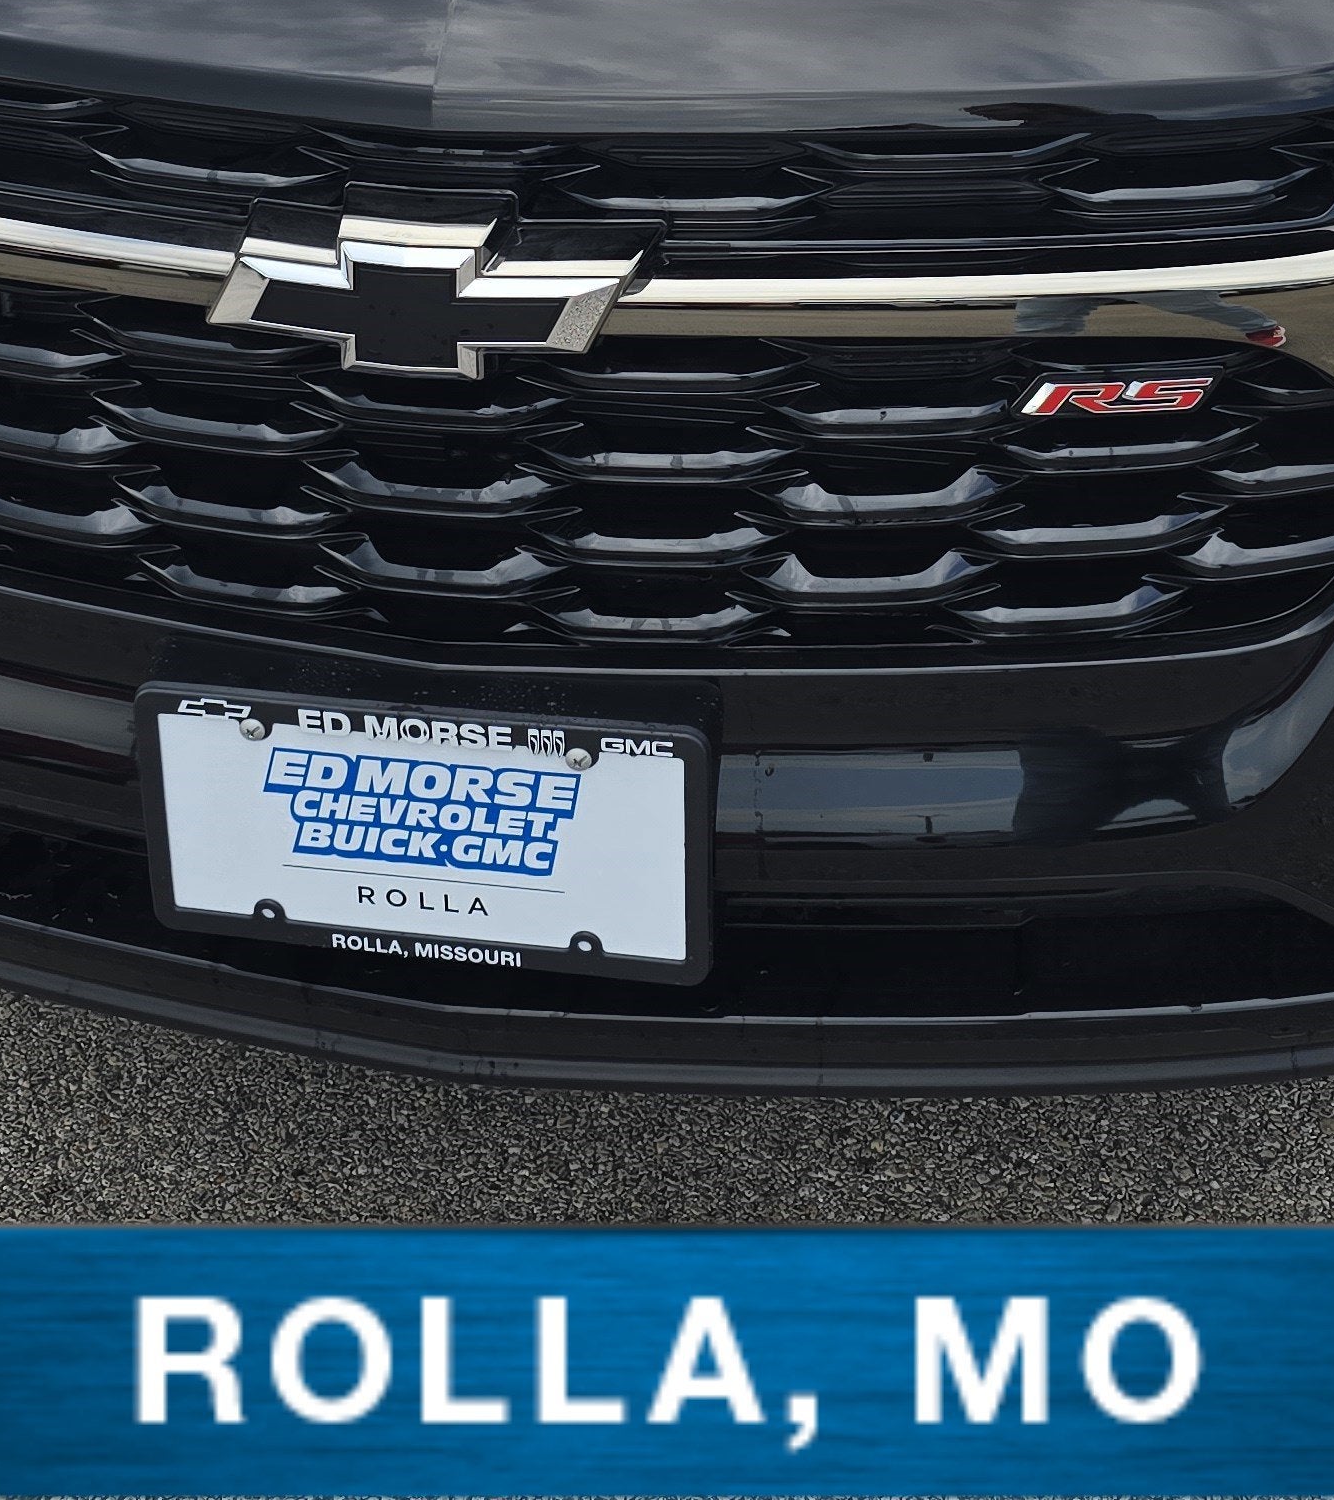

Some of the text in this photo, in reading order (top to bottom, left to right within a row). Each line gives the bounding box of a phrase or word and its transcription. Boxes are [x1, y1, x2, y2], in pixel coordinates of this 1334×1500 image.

[1020, 377, 1214, 416] RS
[297, 708, 514, 751] ED MORSE
[599, 737, 675, 758] GMC
[267, 750, 578, 811] ED MORSE
[292, 790, 555, 840] CHEVROLET
[357, 885, 490, 916] ROLLA
[330, 933, 523, 968] ROLLA, MISSOURI
